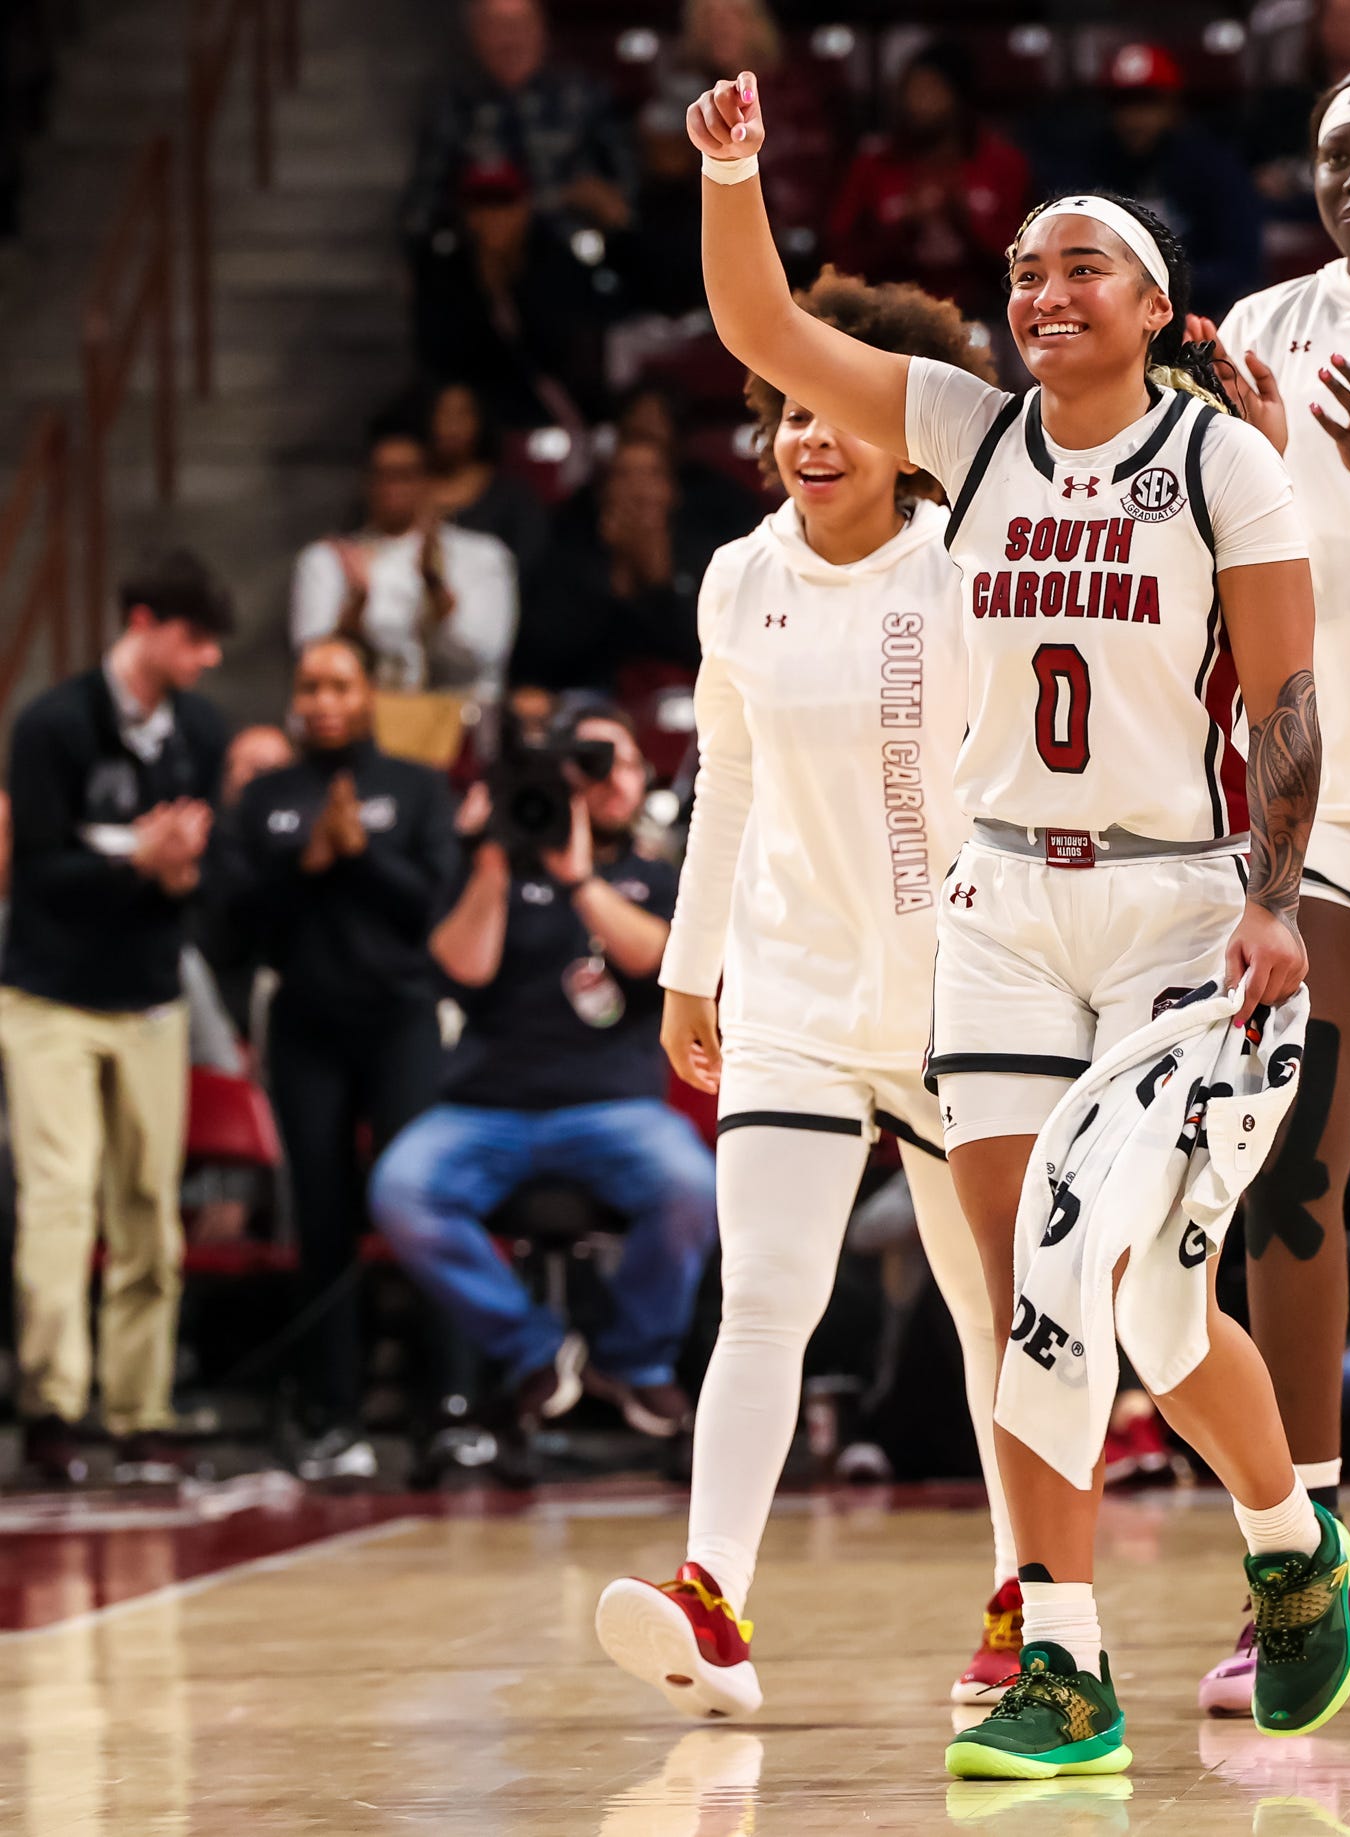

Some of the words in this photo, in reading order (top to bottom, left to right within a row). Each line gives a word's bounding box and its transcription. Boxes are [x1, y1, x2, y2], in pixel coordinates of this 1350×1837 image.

[1126, 503, 1177, 521] GRADUATE
[1134, 470, 1175, 508] SEC
[1004, 516, 1135, 564] SOUTH
[972, 571, 1161, 625] CAROLINA
[881, 612, 923, 728] SOUTH
[1031, 643, 1091, 774] 0
[881, 740, 934, 915] CAROLINA
[1050, 836, 1088, 847] CAROLINA
[1056, 846, 1082, 857] SOUTH
